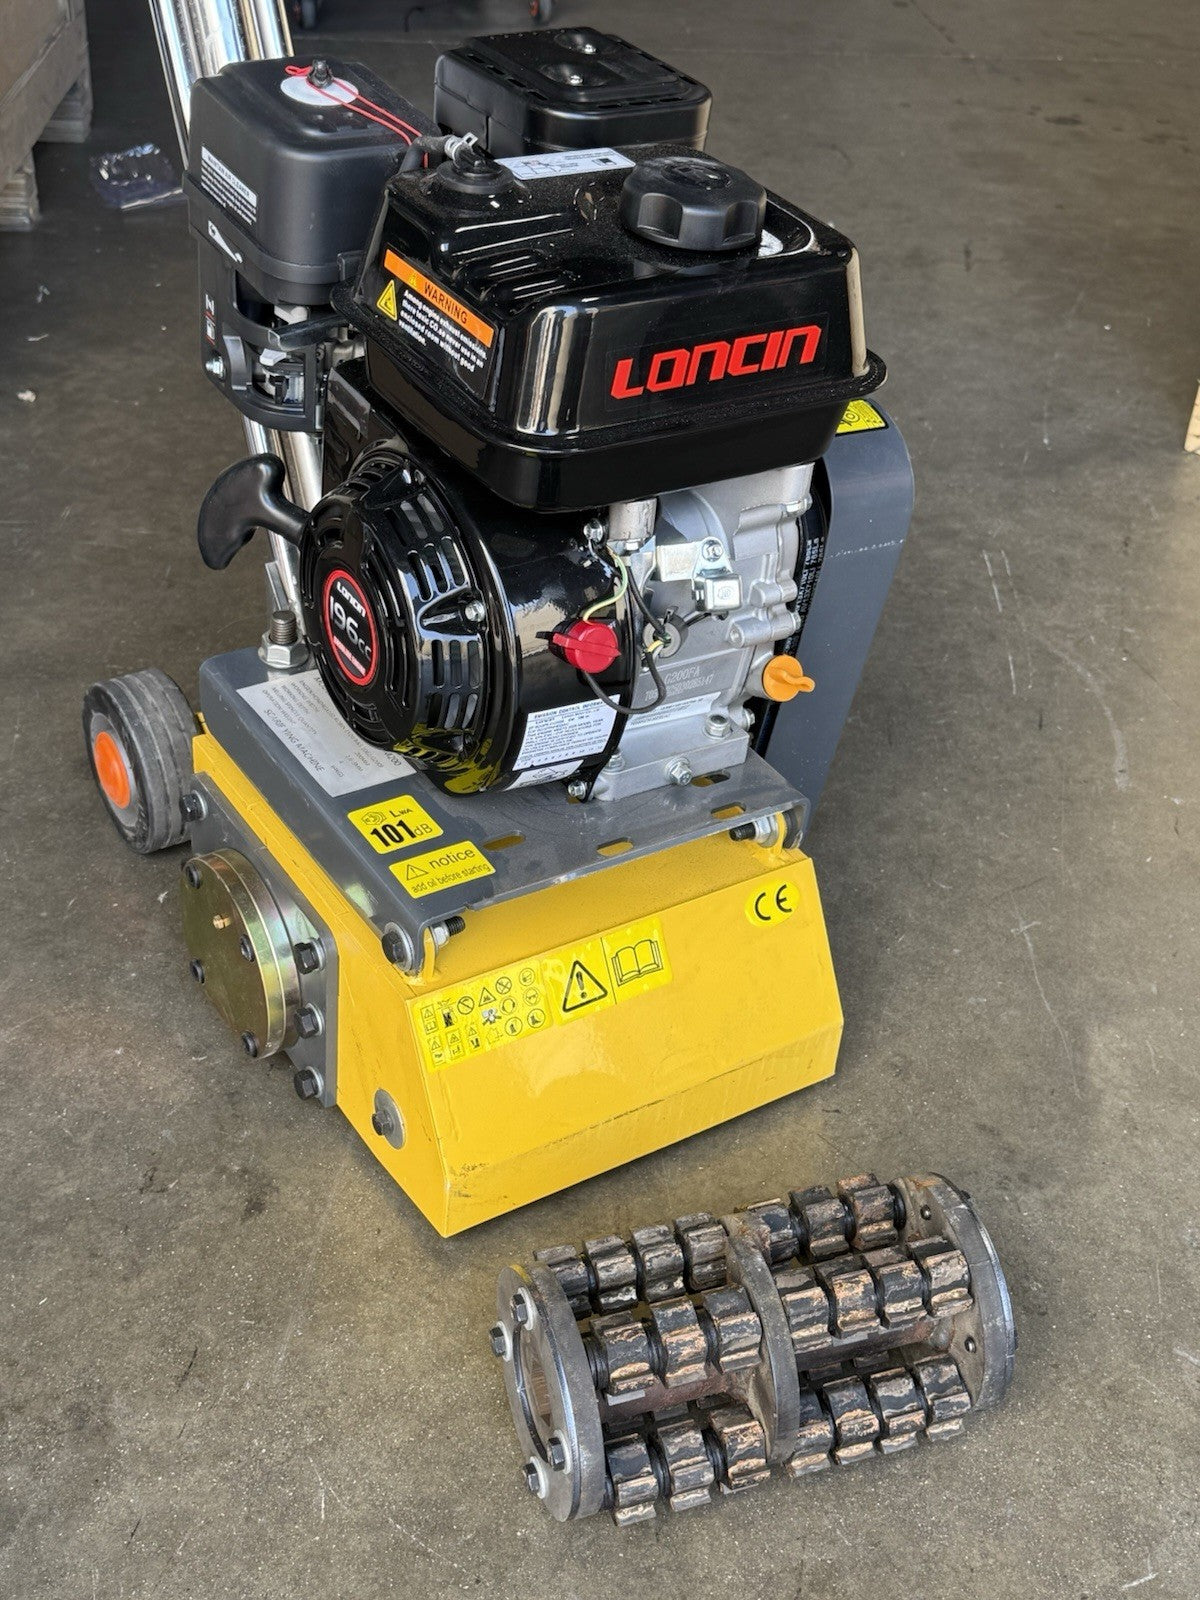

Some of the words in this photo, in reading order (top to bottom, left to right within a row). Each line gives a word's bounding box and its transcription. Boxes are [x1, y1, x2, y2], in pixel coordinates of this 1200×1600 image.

[424, 281, 468, 324] WARNING
[611, 325, 822, 399] LONCIN
[411, 881, 428, 894] add
[427, 876, 438, 889] oil
[437, 871, 462, 886] before
[460, 862, 492, 879] starting
[428, 848, 476, 870] notice
[754, 883, 793, 921] CE
